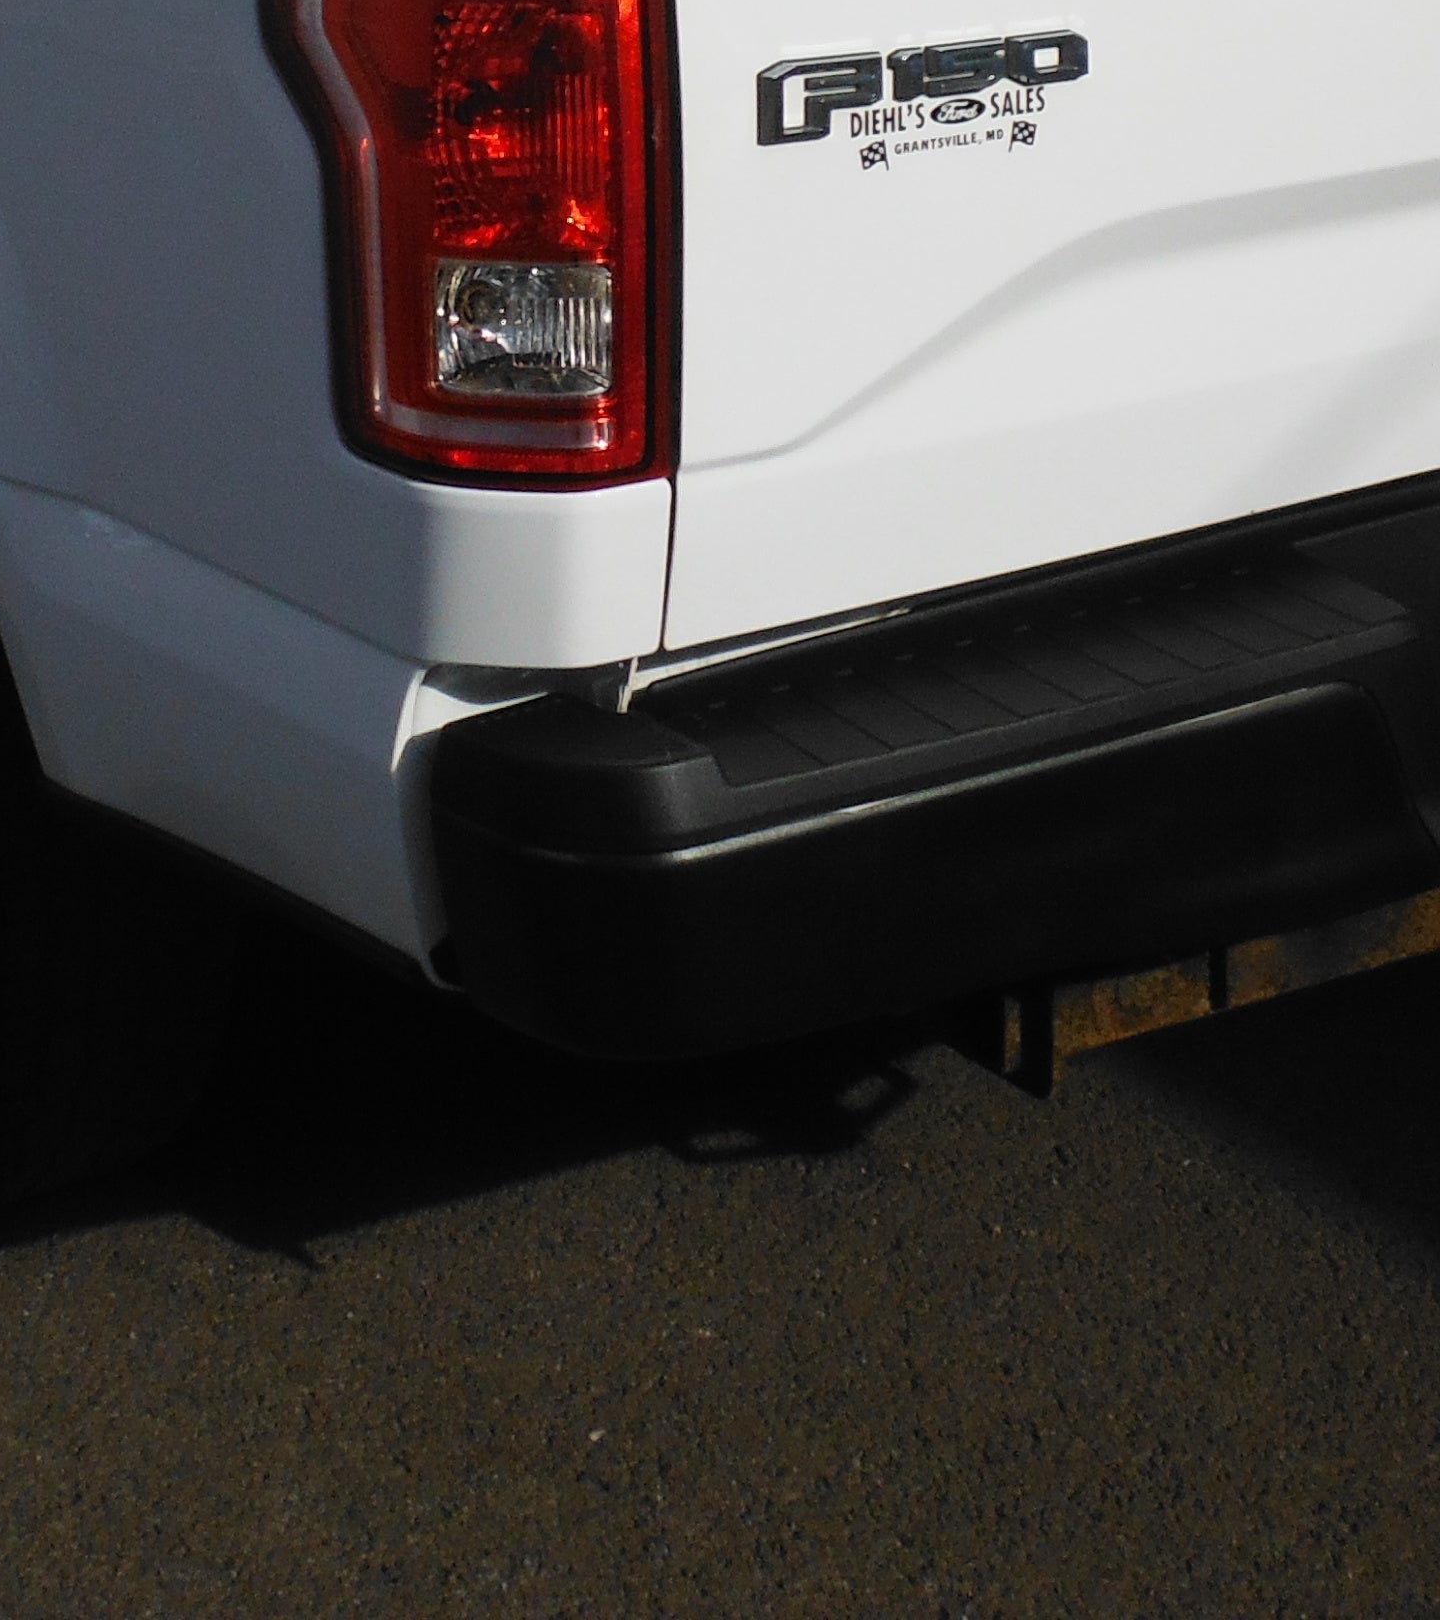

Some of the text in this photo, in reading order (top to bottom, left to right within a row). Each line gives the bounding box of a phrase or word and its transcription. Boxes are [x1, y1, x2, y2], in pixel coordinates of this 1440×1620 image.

[850, 86, 1046, 138] DIEHL'S Ford SALES
[985, 128, 1004, 141] MD
